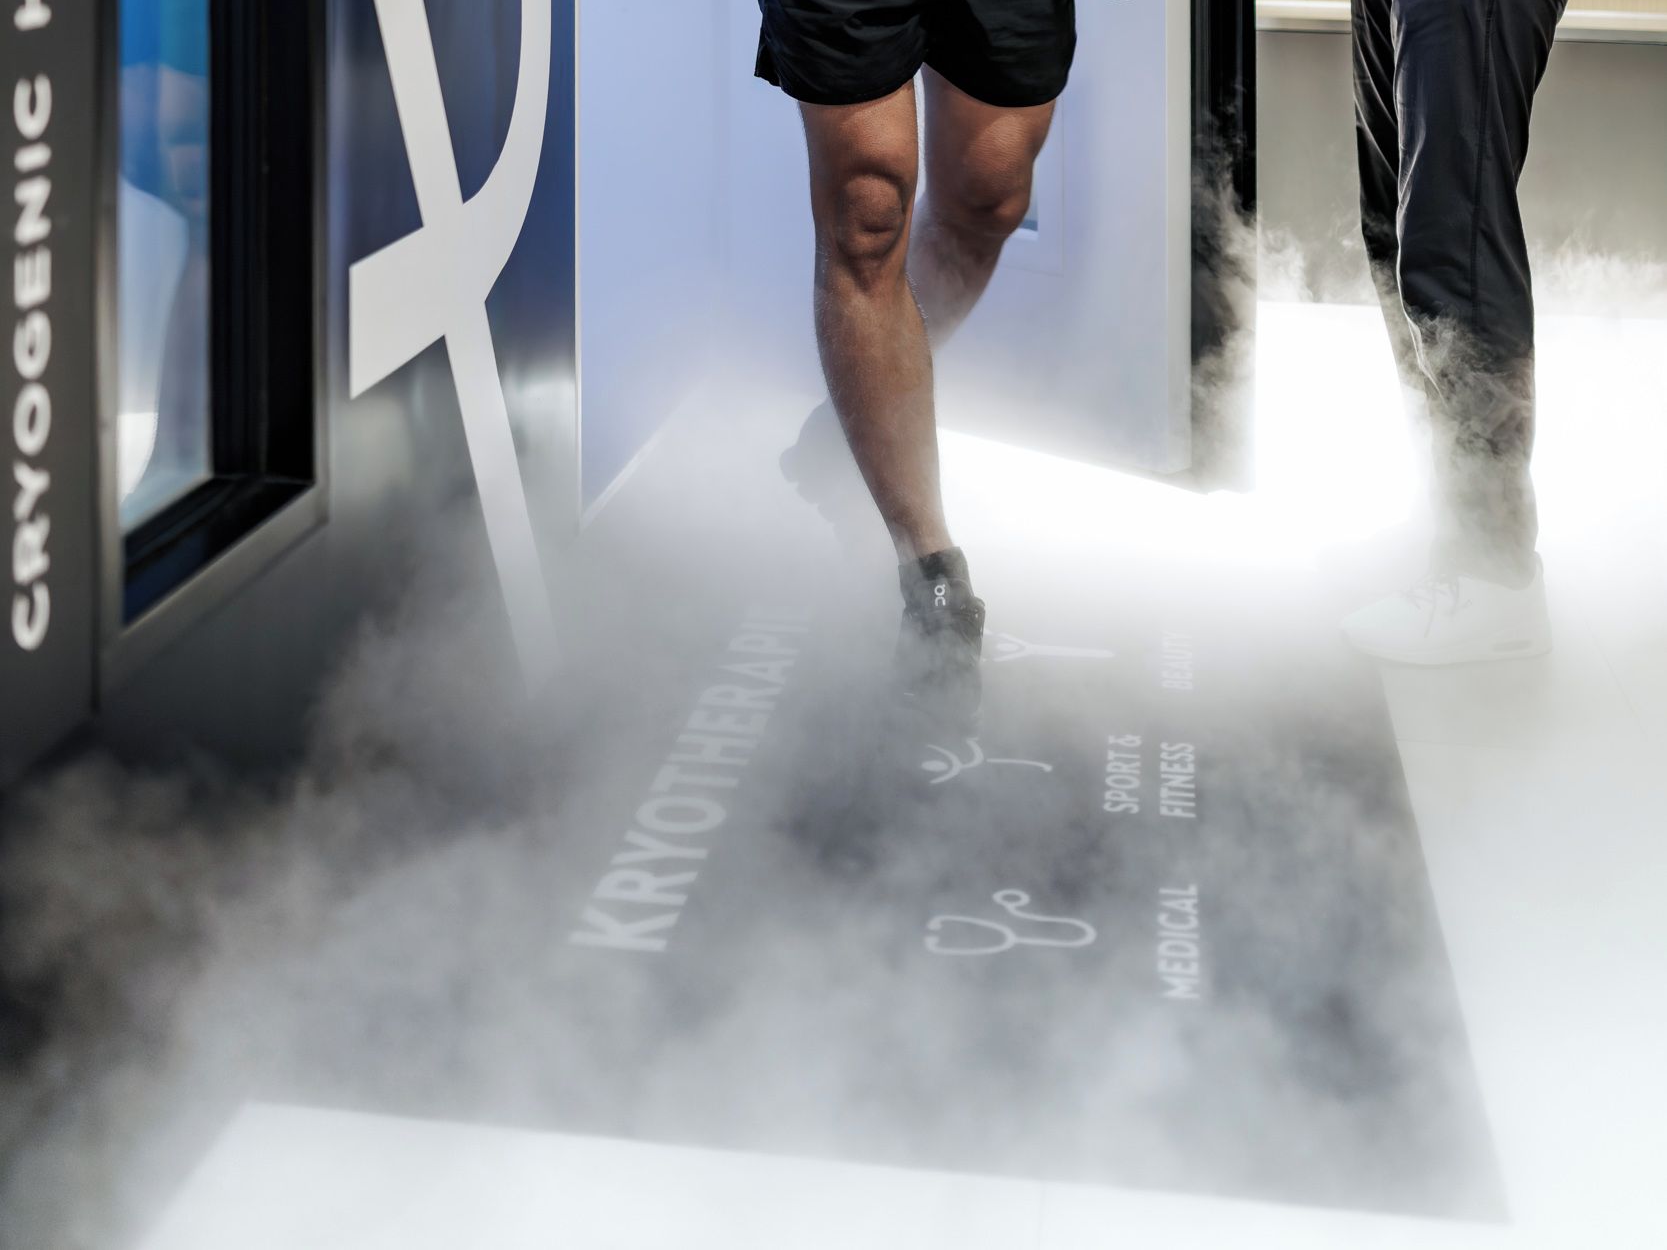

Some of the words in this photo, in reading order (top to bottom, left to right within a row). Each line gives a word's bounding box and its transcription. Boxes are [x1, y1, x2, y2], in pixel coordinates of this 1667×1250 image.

[12, 73, 52, 651] CRYOGENIC
[1107, 733, 1143, 748] &
[1103, 749, 1142, 815] SPORT
[1159, 741, 1197, 819] FITNESS
[1157, 883, 1200, 999] MEDICAL
